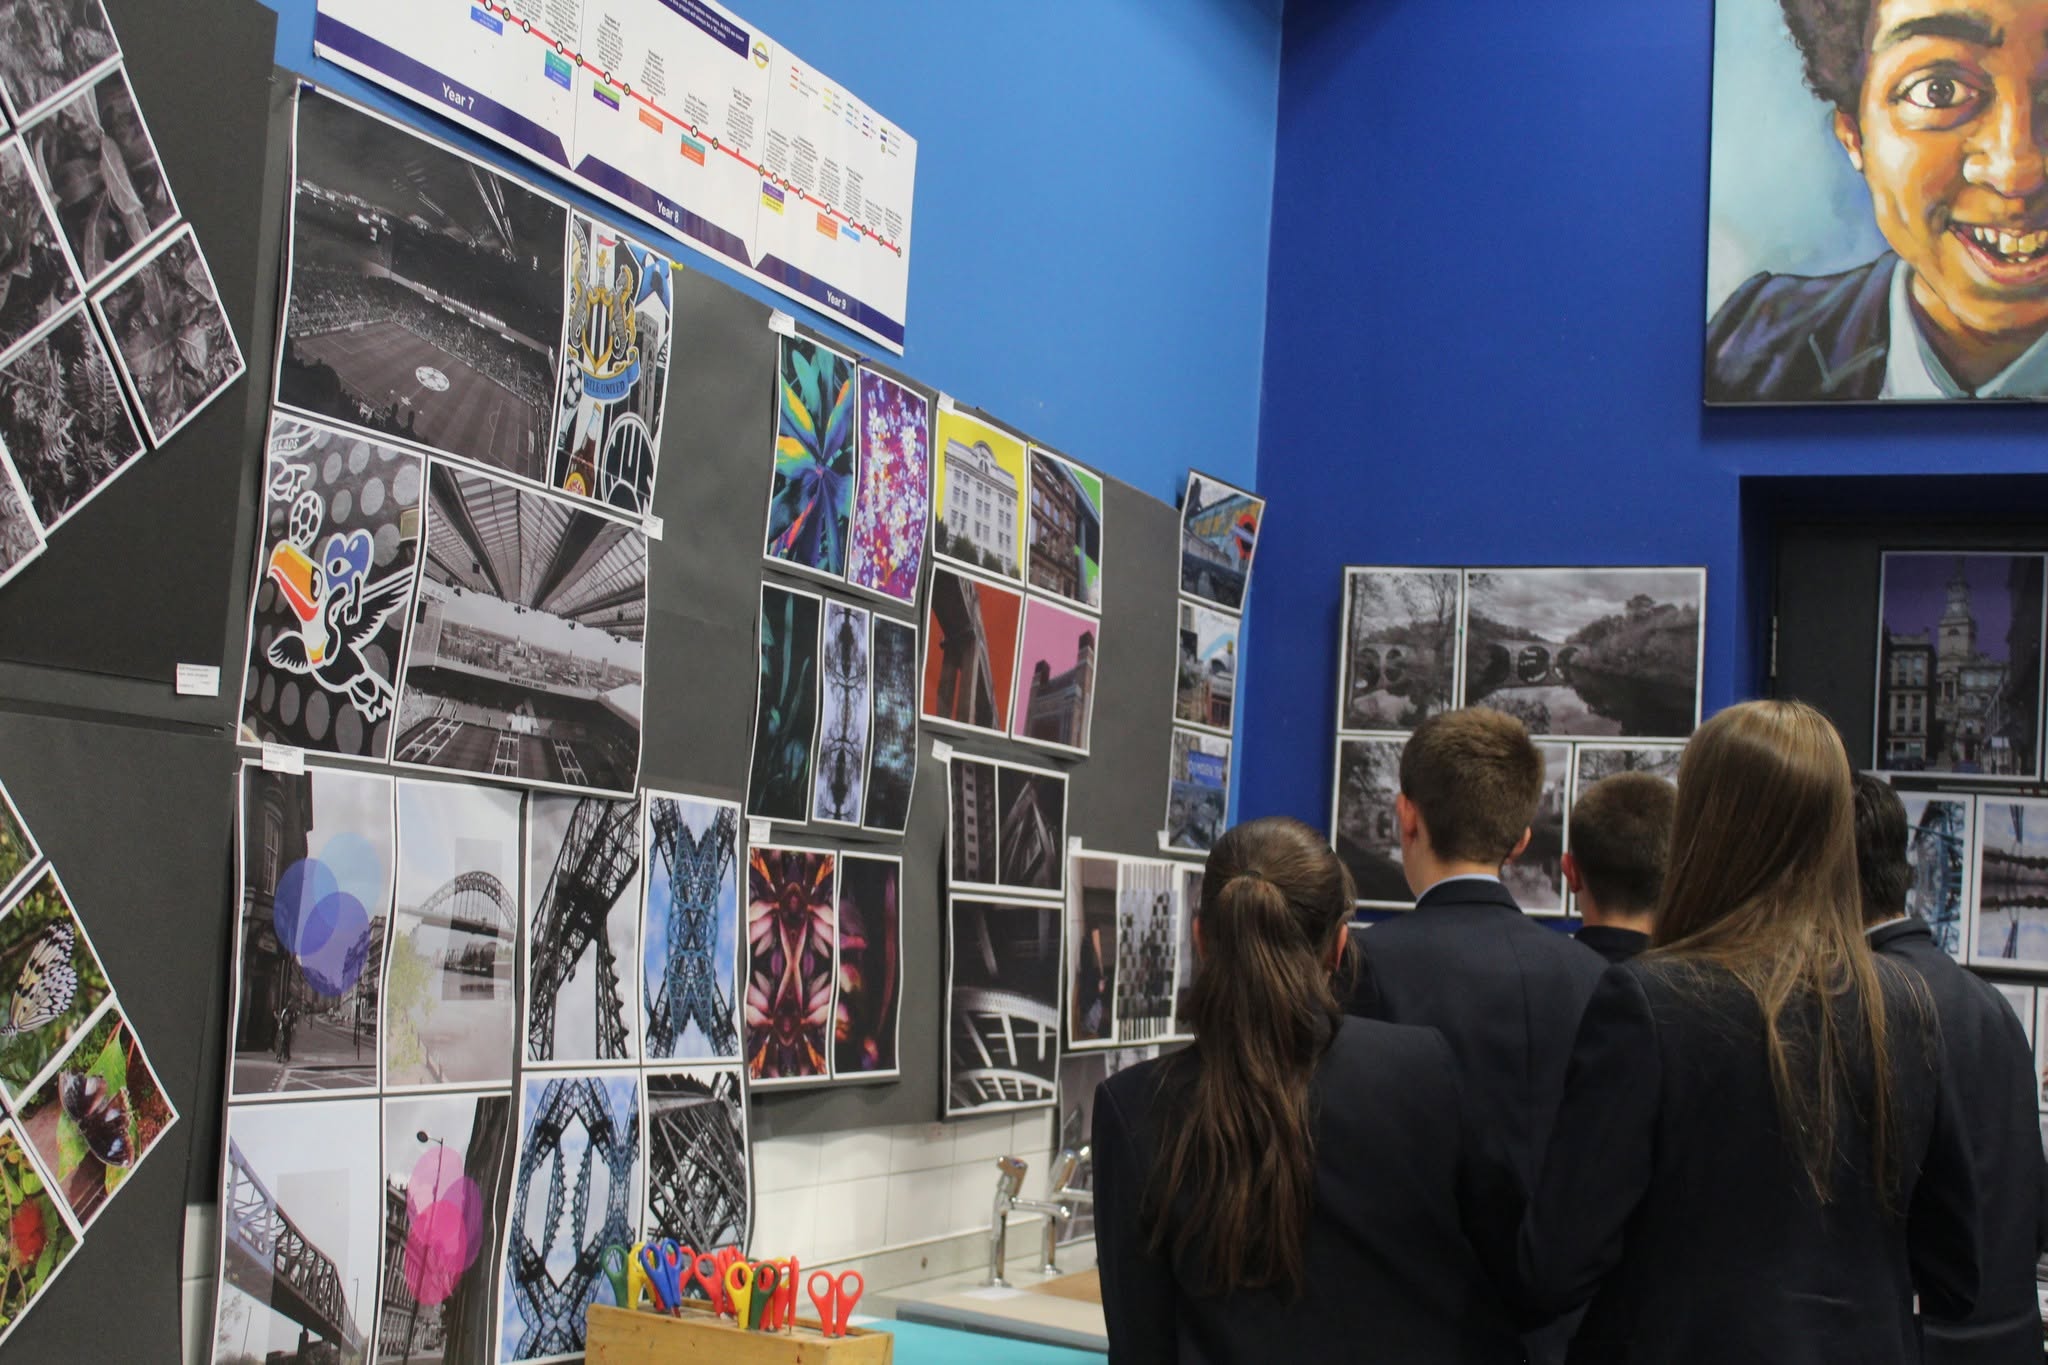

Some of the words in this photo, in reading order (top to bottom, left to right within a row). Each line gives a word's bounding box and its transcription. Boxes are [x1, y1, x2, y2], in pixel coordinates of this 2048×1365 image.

[442, 82, 466, 107] Year
[468, 95, 475, 111] 7
[656, 199, 674, 220] Year
[674, 210, 680, 224] 8
[826, 289, 842, 308] Year
[841, 298, 847, 310] 9
